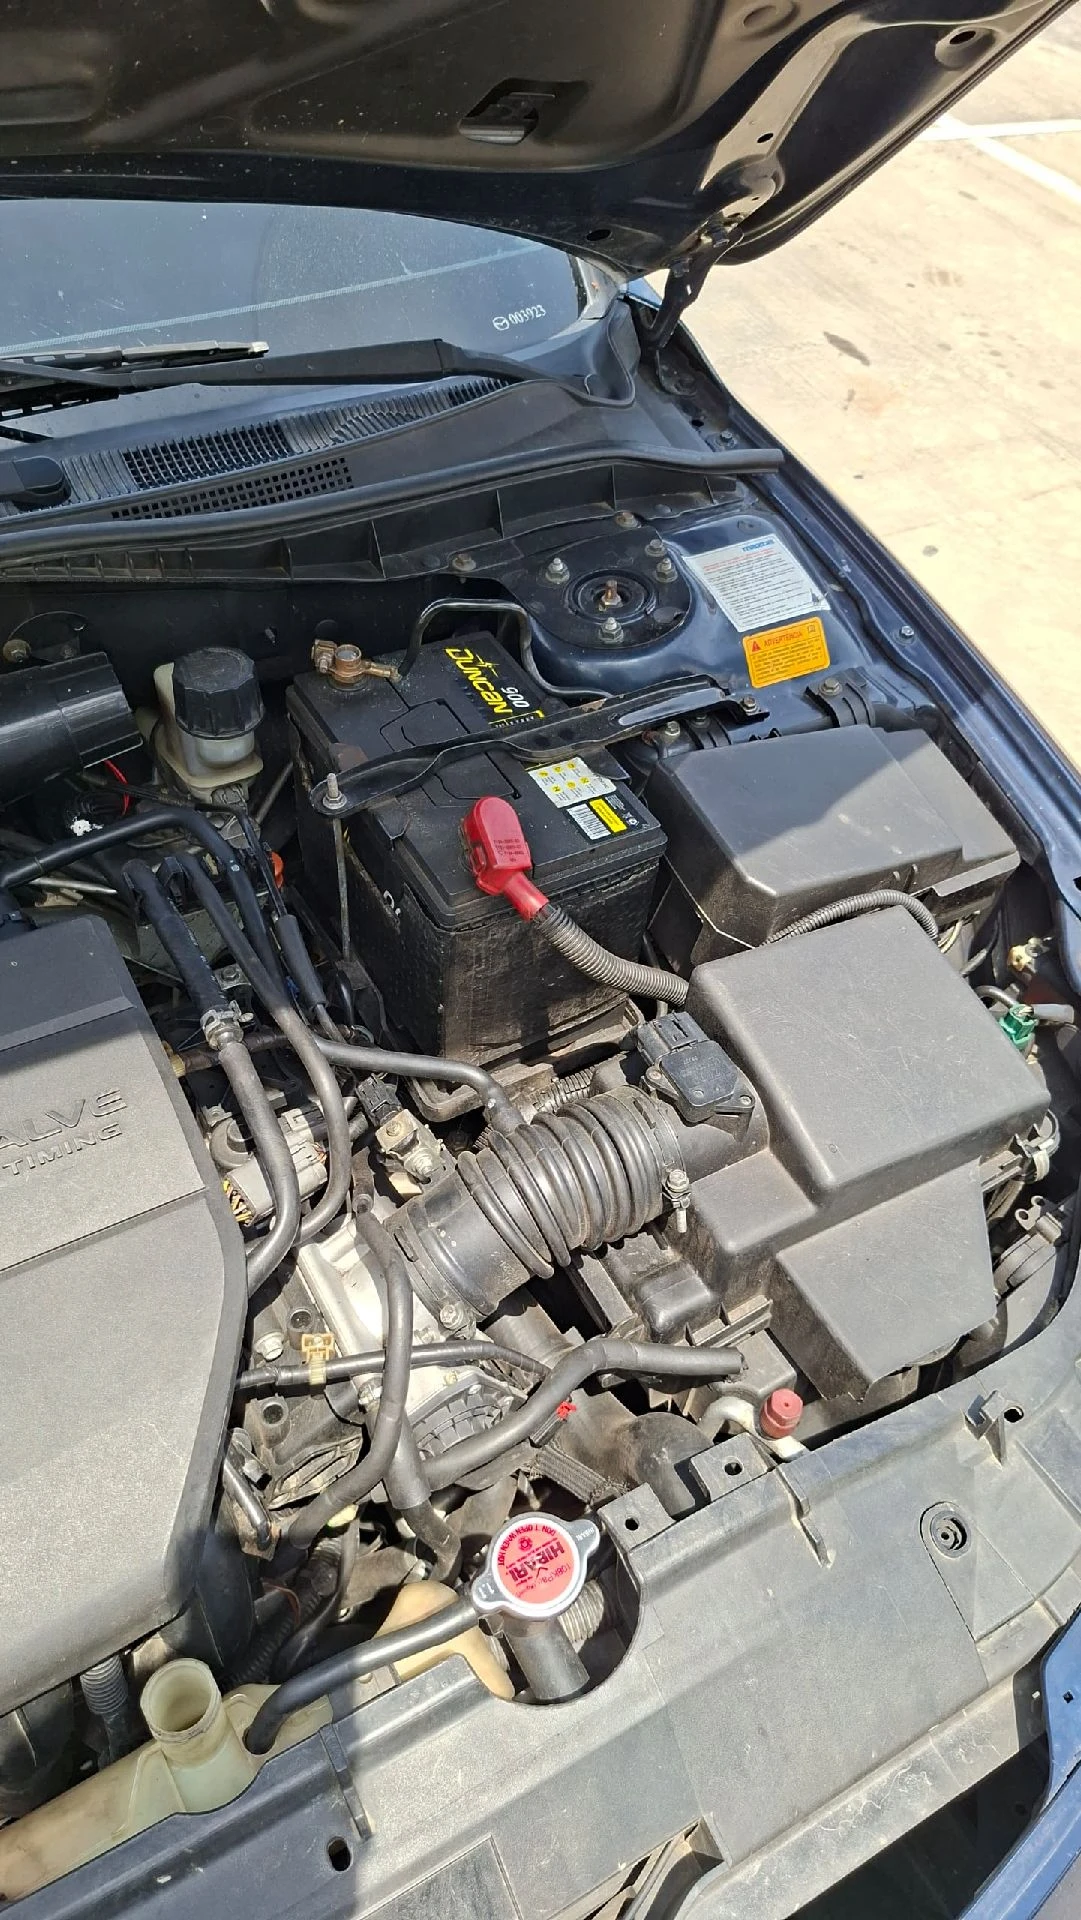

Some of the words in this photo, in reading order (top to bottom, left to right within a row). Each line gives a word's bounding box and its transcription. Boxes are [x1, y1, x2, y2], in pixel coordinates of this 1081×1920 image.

[508, 304, 546, 325] 003923
[501, 686, 530, 708] 900
[2, 1121, 122, 1176] TIMING
[497, 1552, 506, 1566] HOT
